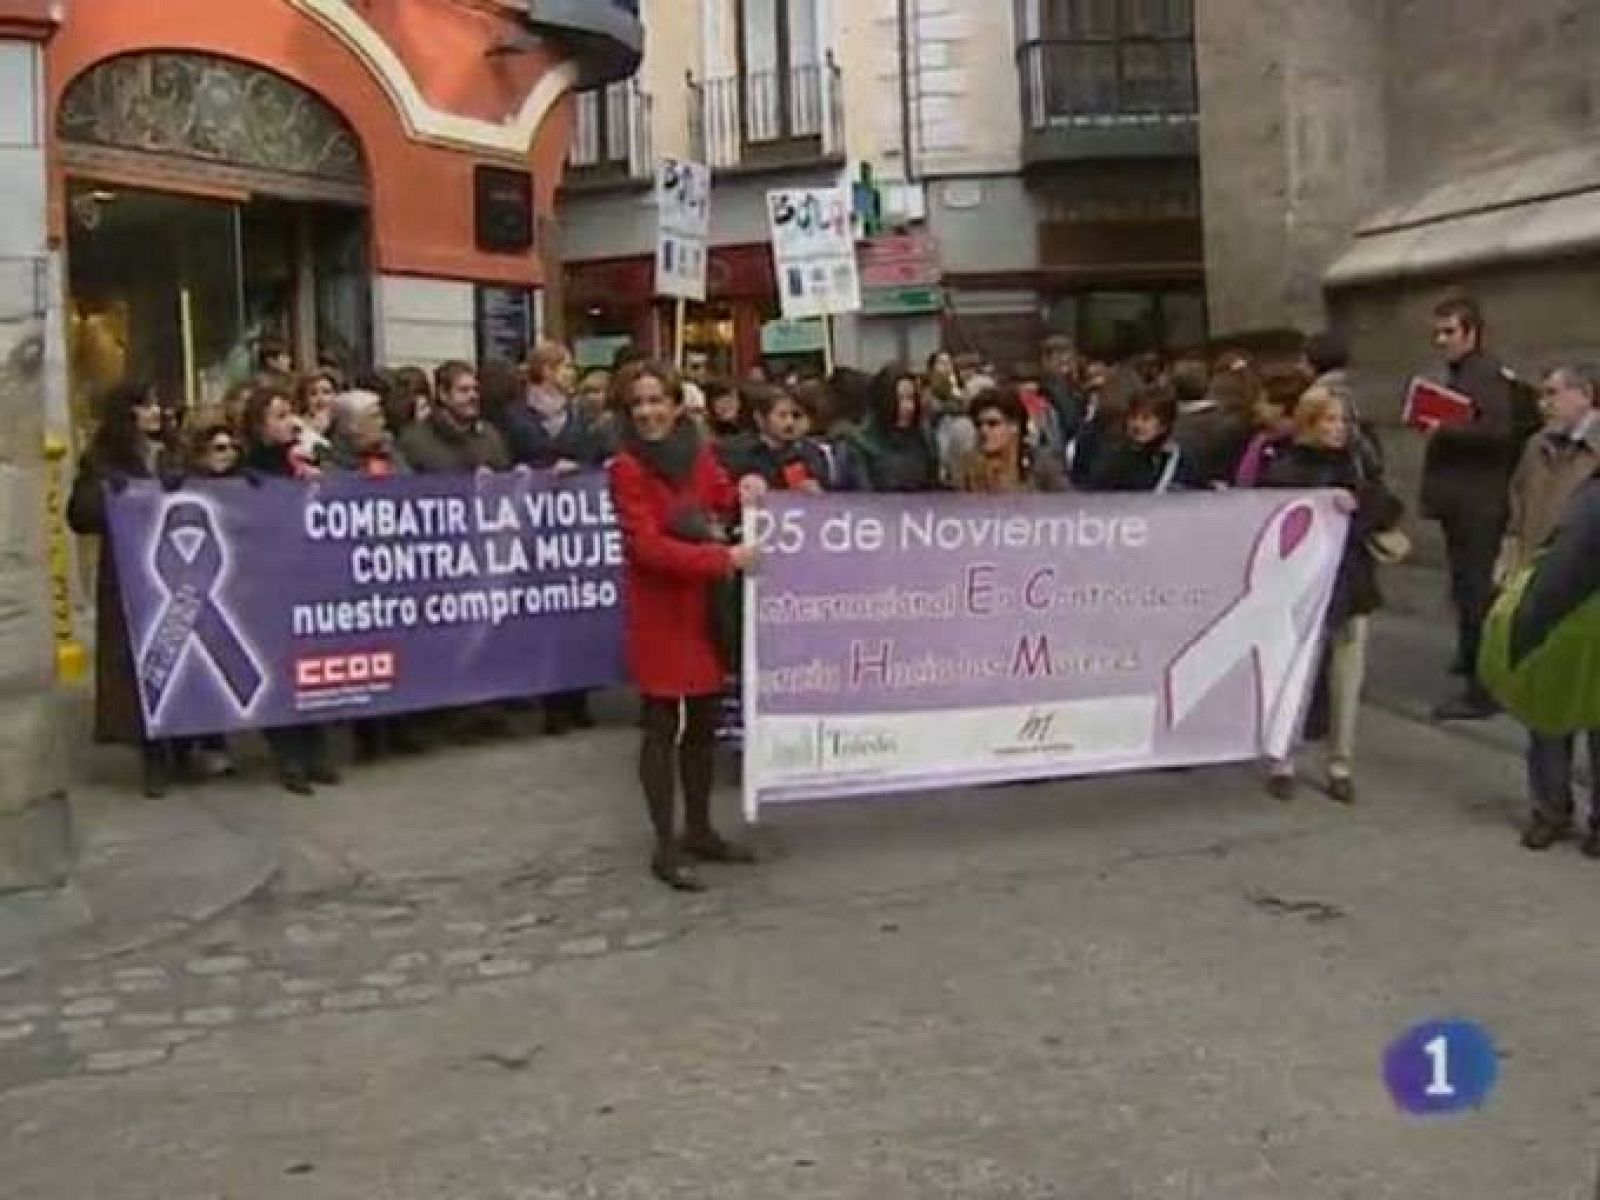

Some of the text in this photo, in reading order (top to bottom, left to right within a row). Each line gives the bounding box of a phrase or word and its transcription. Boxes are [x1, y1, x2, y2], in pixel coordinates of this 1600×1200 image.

[304, 497, 468, 540] COMBATIR
[474, 495, 521, 533] LA
[750, 508, 1149, 554] 25 de Noviembre
[352, 530, 623, 584] CONTRA LA MUJE
[293, 575, 617, 636] nuestro compromiso
[296, 651, 394, 684] CCOO
